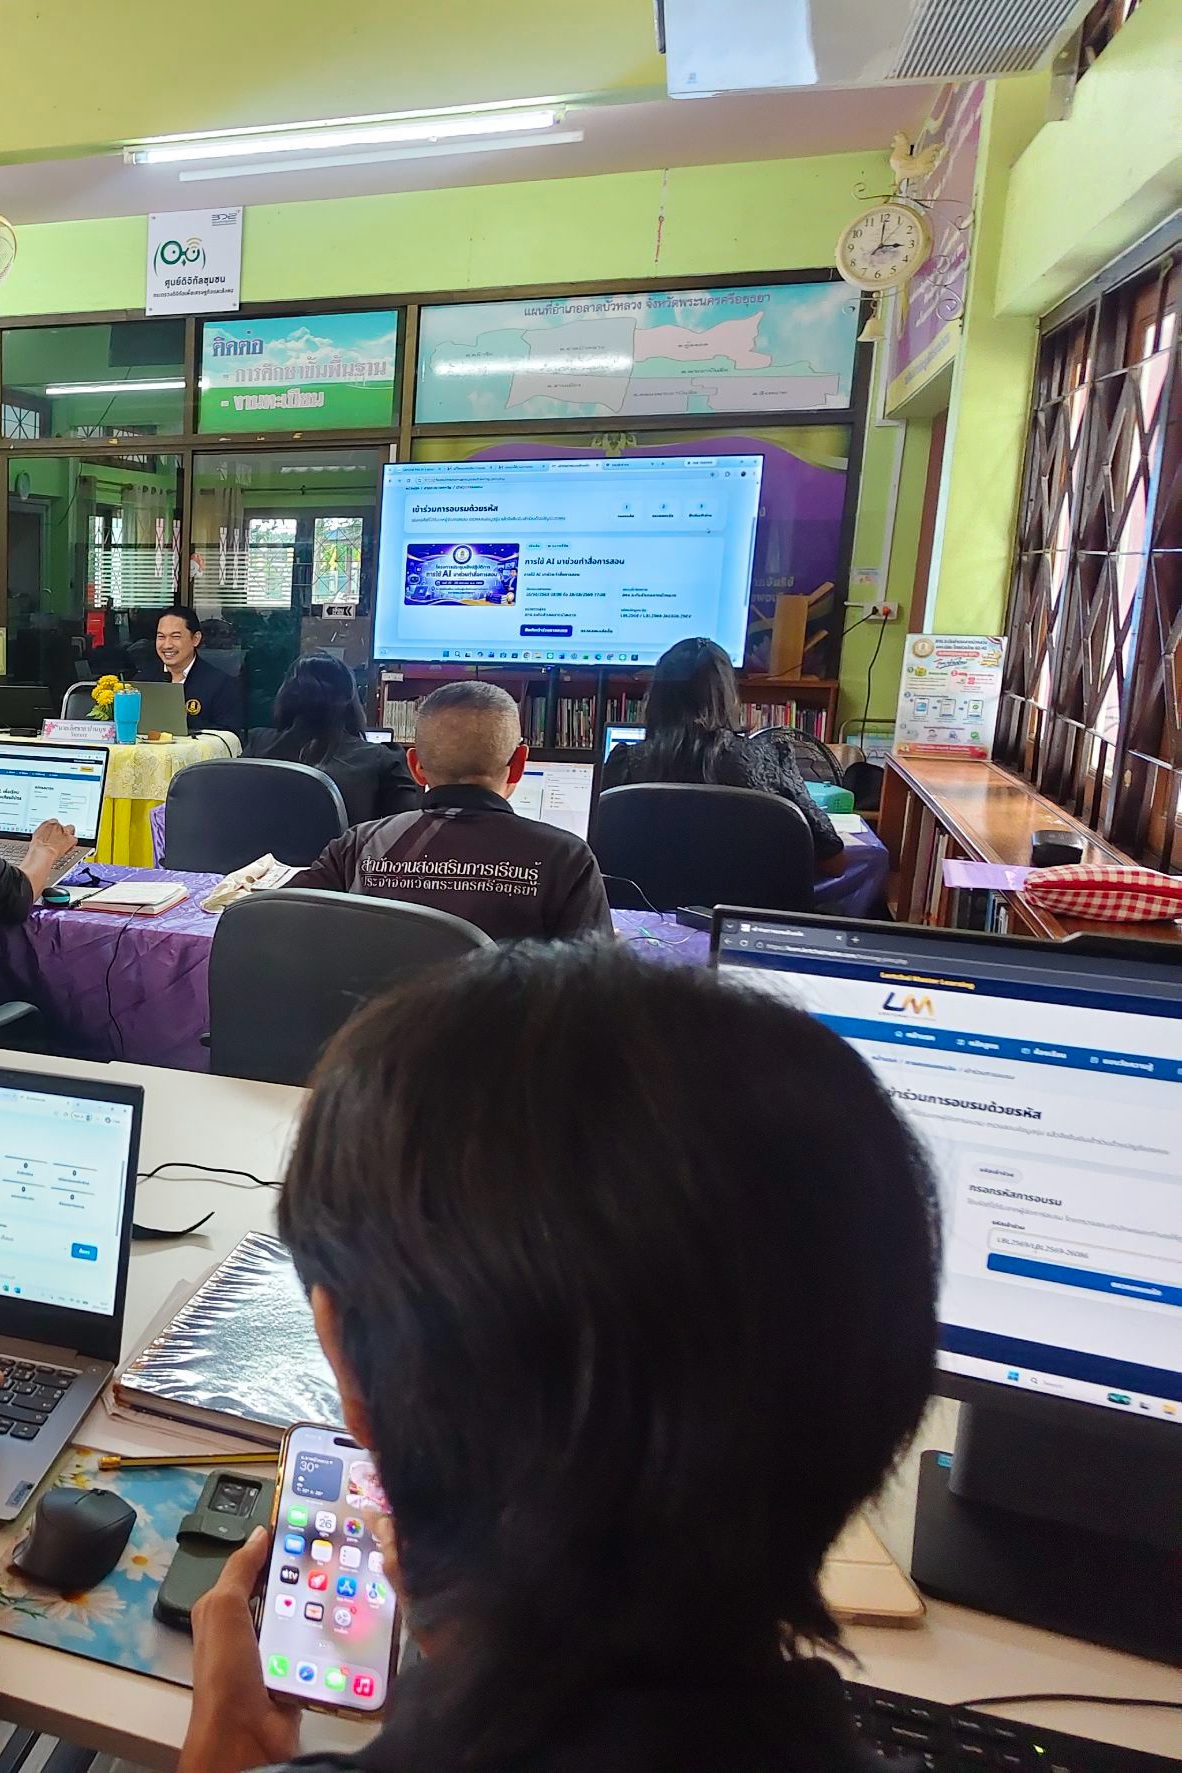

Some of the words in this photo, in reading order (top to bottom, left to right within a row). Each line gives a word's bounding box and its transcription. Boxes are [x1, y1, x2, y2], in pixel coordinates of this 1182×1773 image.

[865, 217, 874, 227] 11
[880, 213, 891, 223] 12
[852, 229, 863, 239] 10
[524, 300, 642, 317] แผนที่อำเภอลาดบัวหลวง
[646, 293, 772, 310] จังหวัดพระนครศรีอยุธยา
[213, 330, 264, 357] ติดต่อ
[361, 854, 542, 887] สำนักงานส่งเสริมการเรียนรู้
[882, 992, 934, 1016] LM
[886, 1085, 1042, 1120] ข้าร่วมการอบรมด้วยรหัส
[968, 1184, 1063, 1207] กรอกรหัสการอบรม
[319, 1518, 332, 1529] 26
